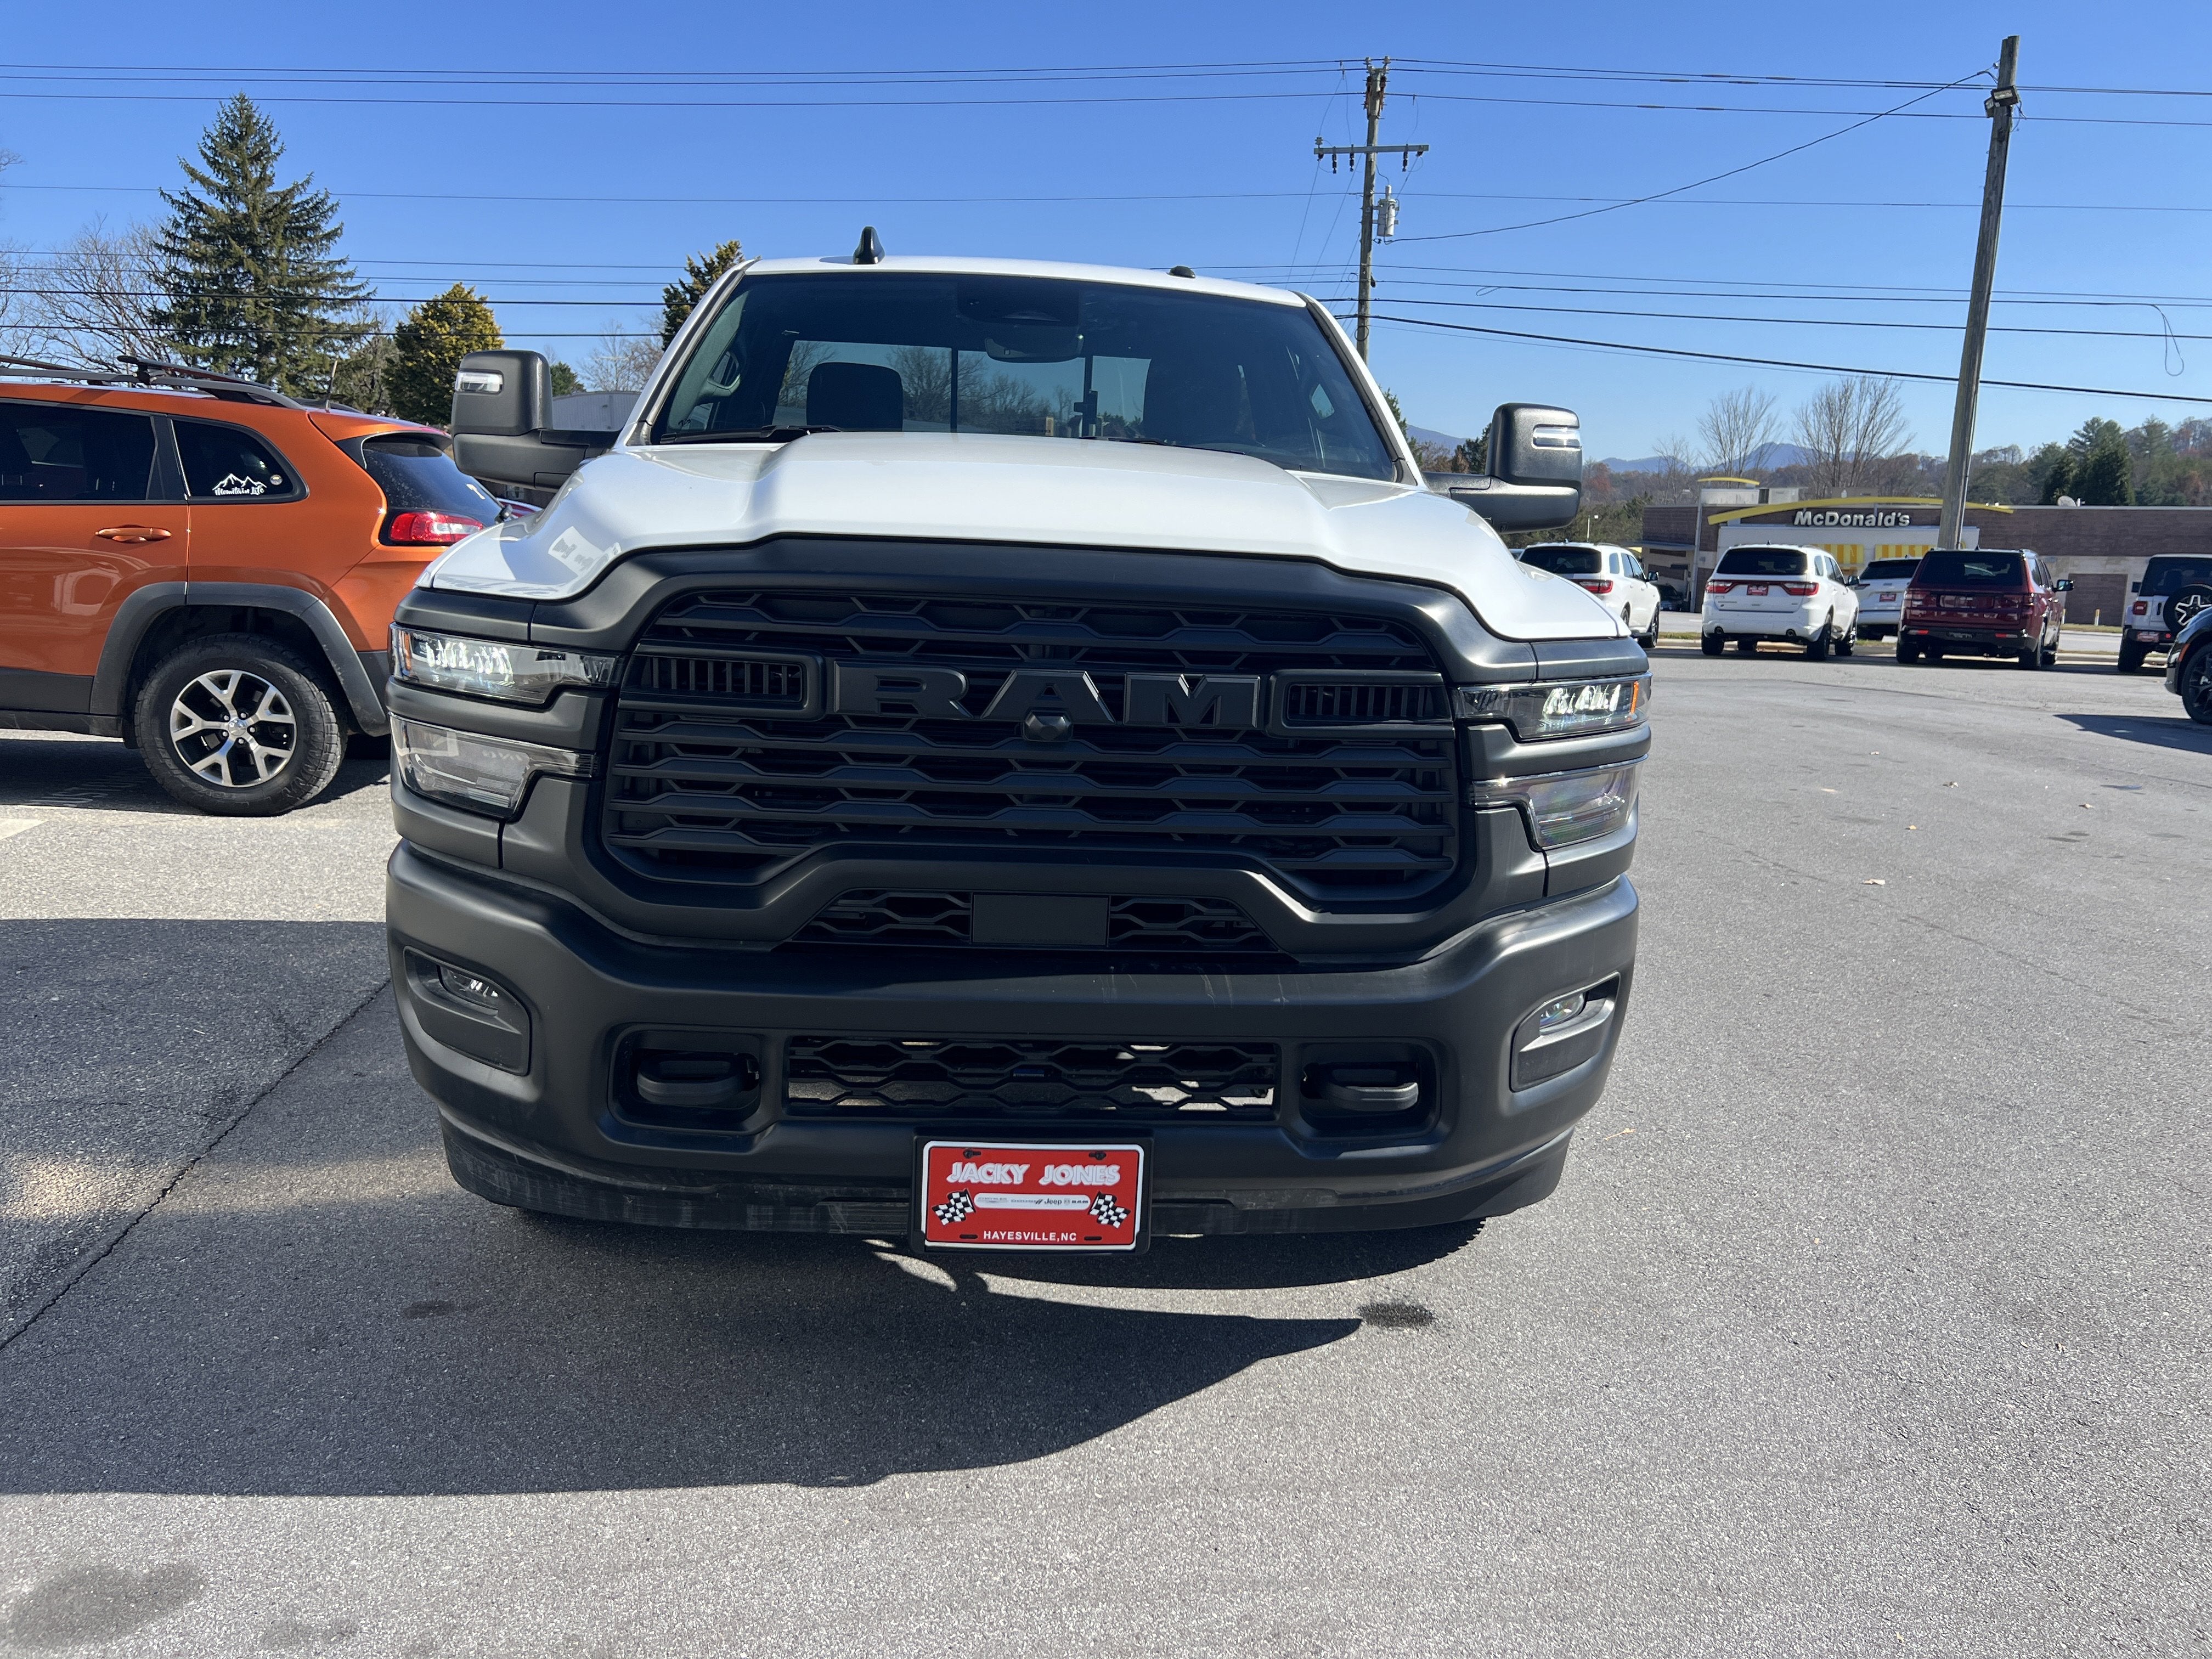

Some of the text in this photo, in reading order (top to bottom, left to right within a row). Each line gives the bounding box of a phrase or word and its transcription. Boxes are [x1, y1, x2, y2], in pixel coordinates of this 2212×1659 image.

[215, 486, 264, 496] Mountain Life
[1793, 511, 1910, 527] McDonald's
[833, 660, 1261, 729] RAM
[946, 1161, 1121, 1186] JACKY JONES
